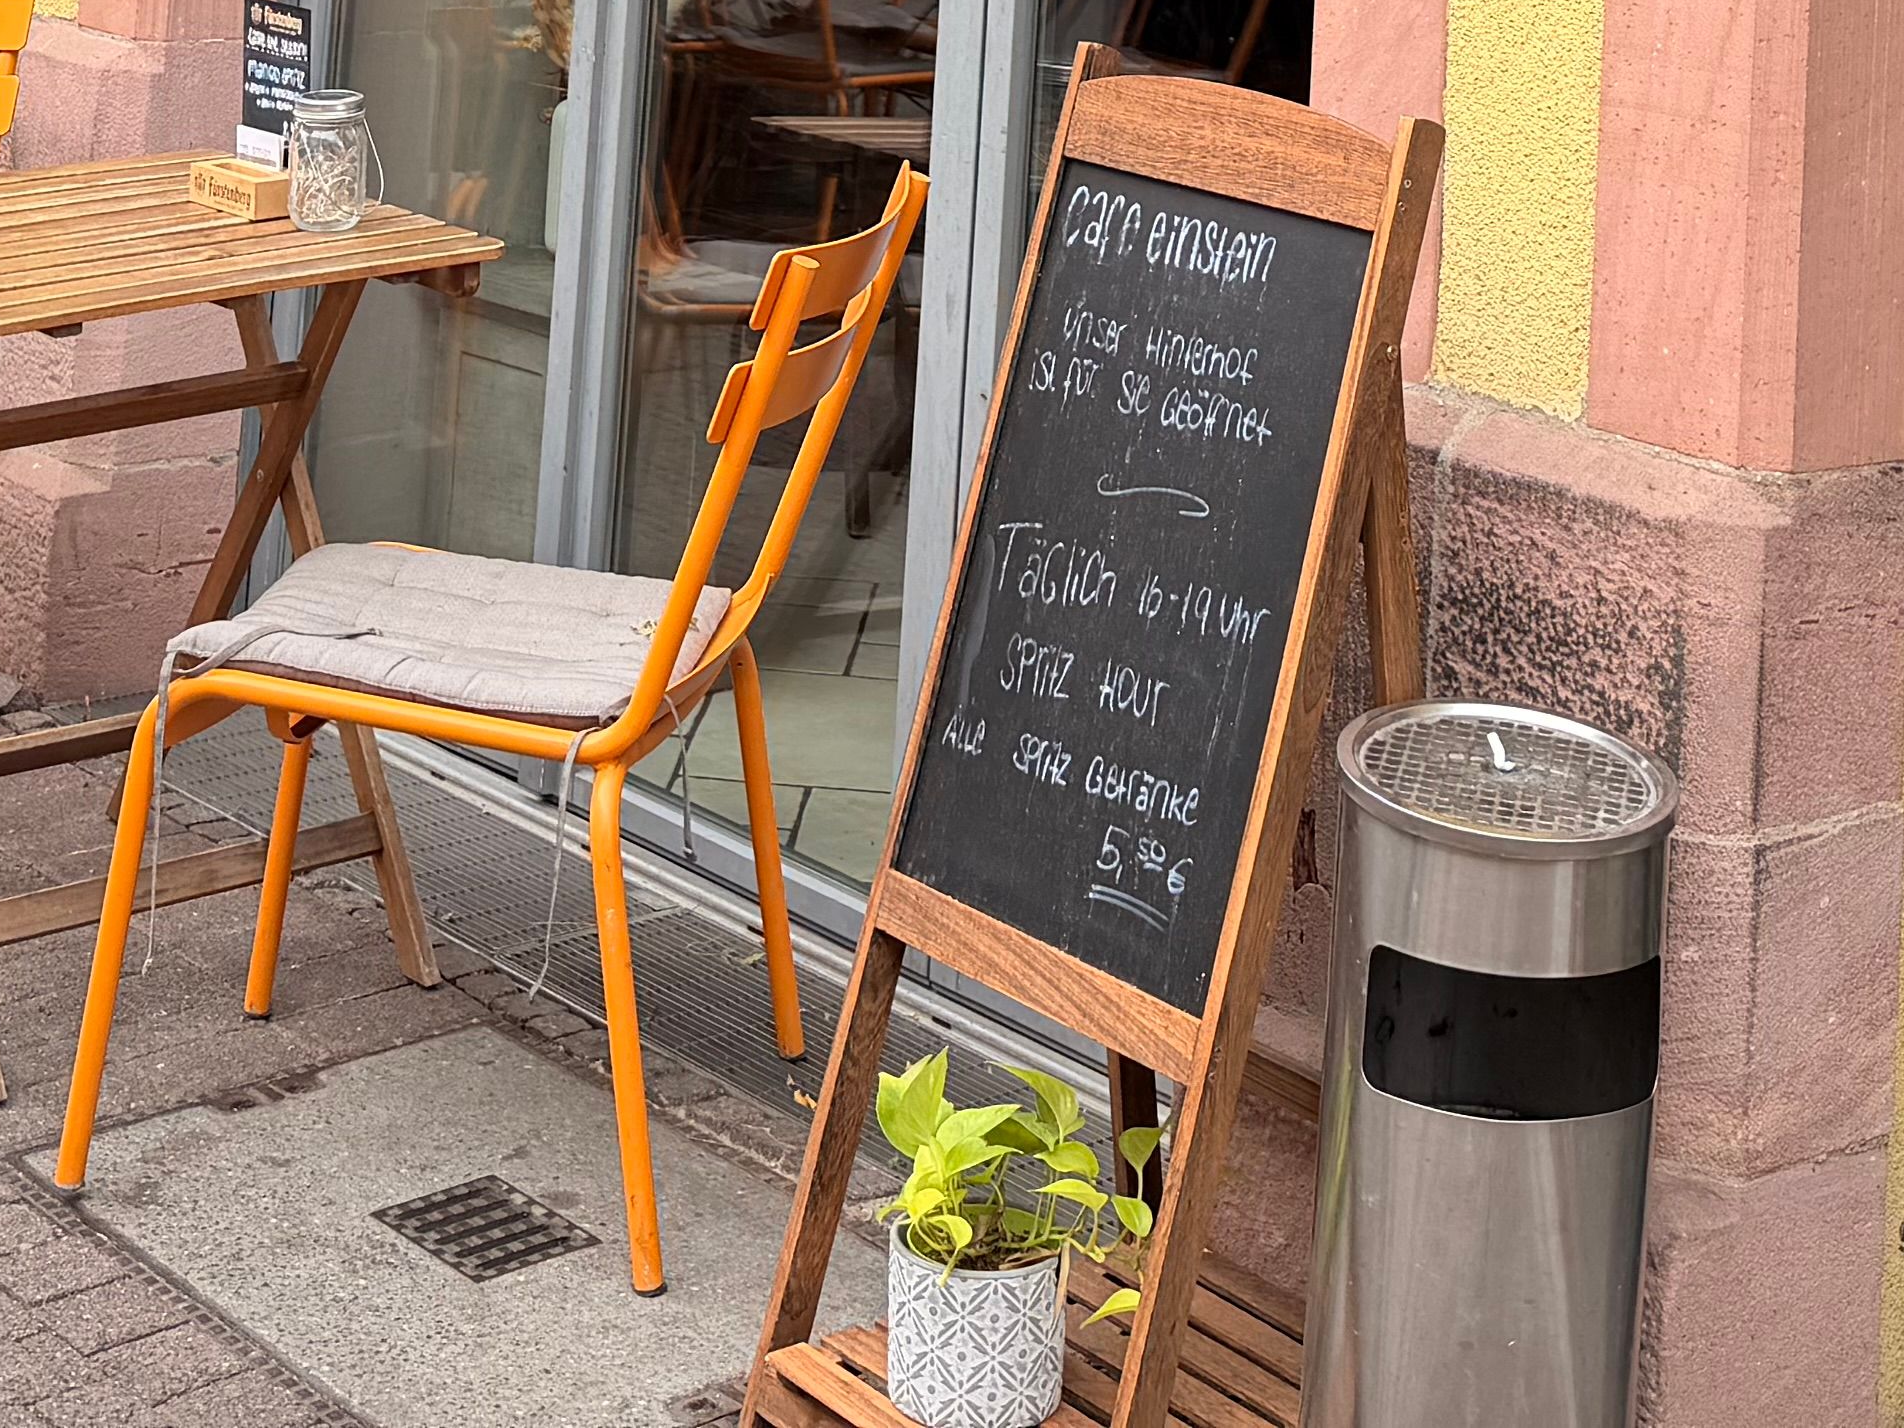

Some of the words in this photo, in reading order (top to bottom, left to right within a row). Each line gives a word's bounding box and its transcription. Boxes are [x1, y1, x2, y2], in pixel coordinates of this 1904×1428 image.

[1146, 211, 1277, 284] einstein
[1145, 326, 1258, 385] Hinterhof
[1138, 566, 1212, 636] 16-19
[1085, 755, 1200, 826] Getränke
